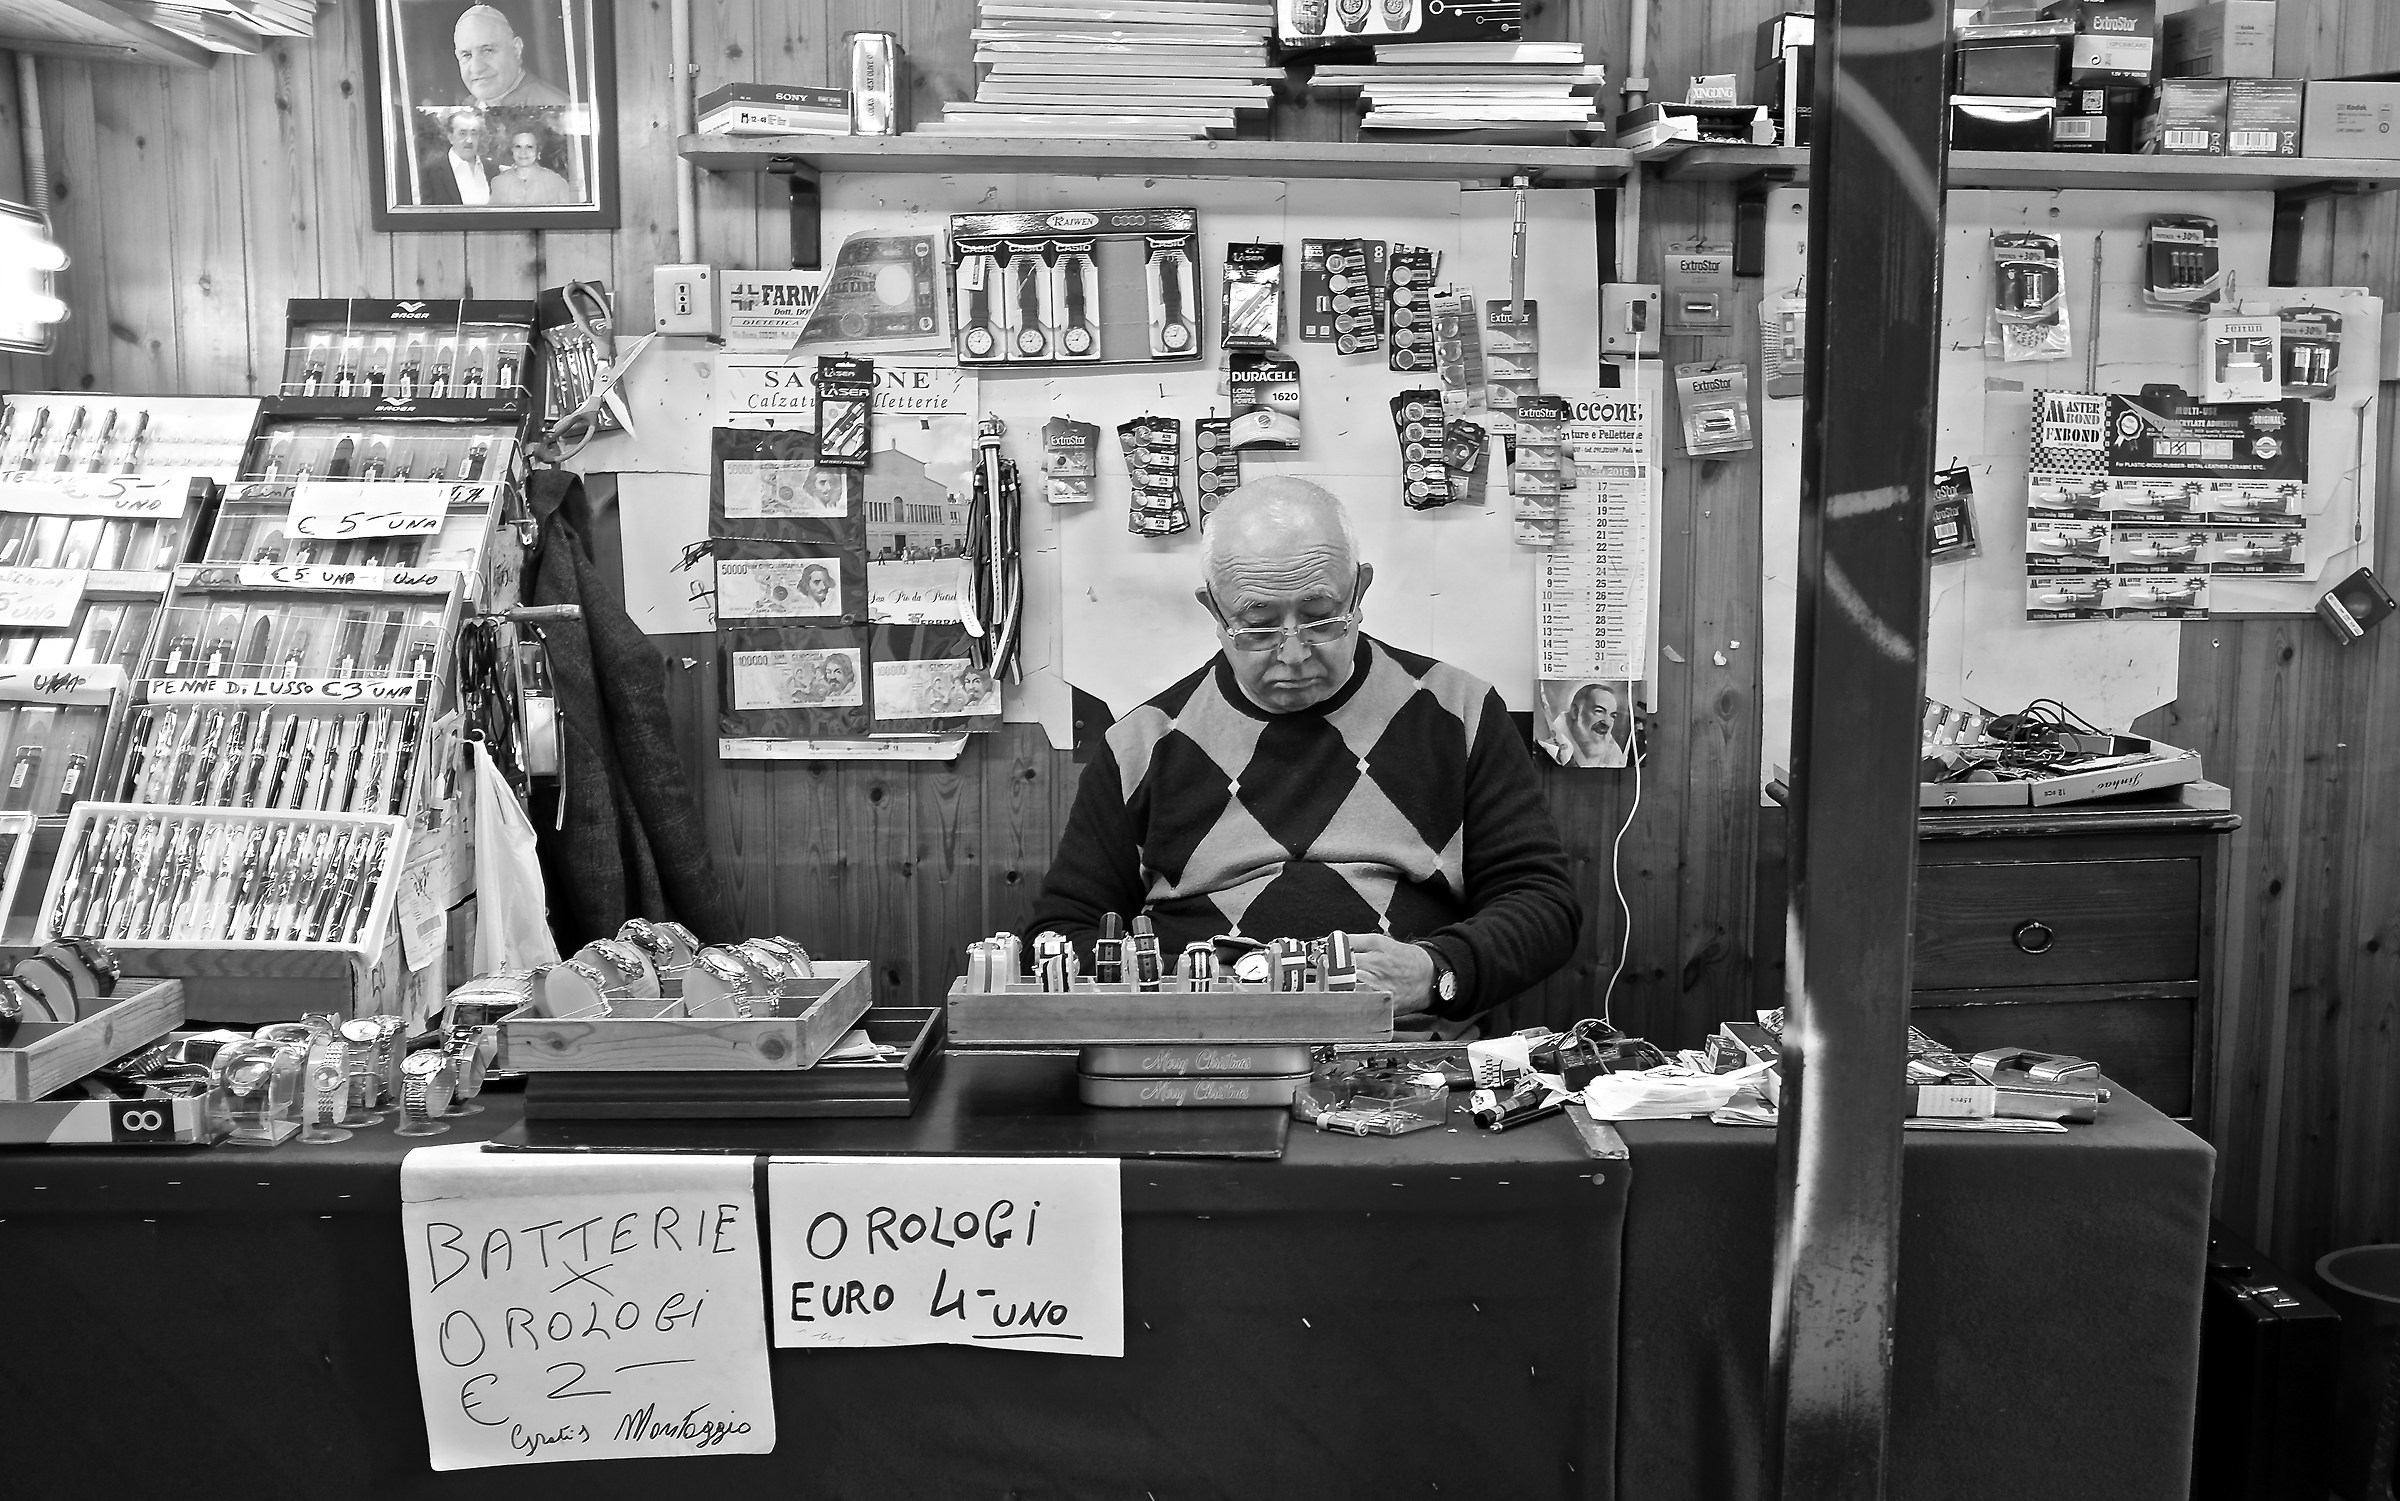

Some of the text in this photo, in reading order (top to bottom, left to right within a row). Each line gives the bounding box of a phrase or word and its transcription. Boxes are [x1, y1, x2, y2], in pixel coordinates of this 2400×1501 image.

[2093, 16, 2138, 31] ExtraStar
[1693, 87, 1733, 98] XINGDING
[775, 93, 808, 101] SONY
[1052, 215, 1095, 227] RAIWEN
[1374, 246, 1383, 257] 8
[1680, 260, 1721, 271] ExtraStar
[761, 285, 819, 306] FARM
[1231, 371, 1297, 382] DURACELL
[1692, 379, 1732, 392] ExtraStar
[1272, 393, 1298, 401] 1620
[1518, 408, 1559, 418] ExtraStar
[2046, 401, 2100, 422] MASTER
[2066, 413, 2101, 425] BOND
[1572, 430, 1589, 439] ture
[1051, 435, 1087, 445] ExtraStar
[1608, 468, 1630, 477] 2016
[1598, 483, 1607, 491] 17
[1597, 495, 1607, 503] 18
[1597, 507, 1607, 515] 19
[298, 516, 316, 535] €
[388, 519, 437, 530] UNA
[1597, 519, 1607, 527] 20
[1597, 531, 1607, 539] 21
[1597, 543, 1607, 551] 22
[1548, 555, 1552, 563] 7
[1597, 556, 1606, 564] 23
[721, 564, 748, 575] 50000
[1548, 567, 1552, 575] 8
[1596, 568, 1606, 576] 24
[322, 573, 356, 585] UNA
[1548, 579, 1552, 587] 9
[1596, 580, 1606, 588] 25
[1543, 592, 1552, 600] 10
[1596, 592, 1606, 600] 26
[1543, 604, 1552, 612] 11
[1596, 604, 1606, 612] 27
[1543, 616, 1552, 624] 12
[1596, 616, 1606, 624] 28
[1543, 628, 1552, 636] 13
[1596, 628, 1606, 636] 29
[1543, 640, 1552, 648] 14
[1595, 641, 1605, 649] 30
[1543, 652, 1552, 660] 15
[1595, 653, 1605, 661] 31
[738, 655, 768, 666] 100000
[1543, 664, 1552, 672] 16
[253, 681, 313, 696] LUSSO
[1142, 1048, 1252, 1075] Merry Christmas
[1140, 1081, 1249, 1106] Merry Christmas
[426, 1204, 739, 1293] BATTERIE
[791, 1280, 894, 1321] EURO
[460, 1373, 509, 1426] €
[613, 1402, 752, 1448] Montaggio
